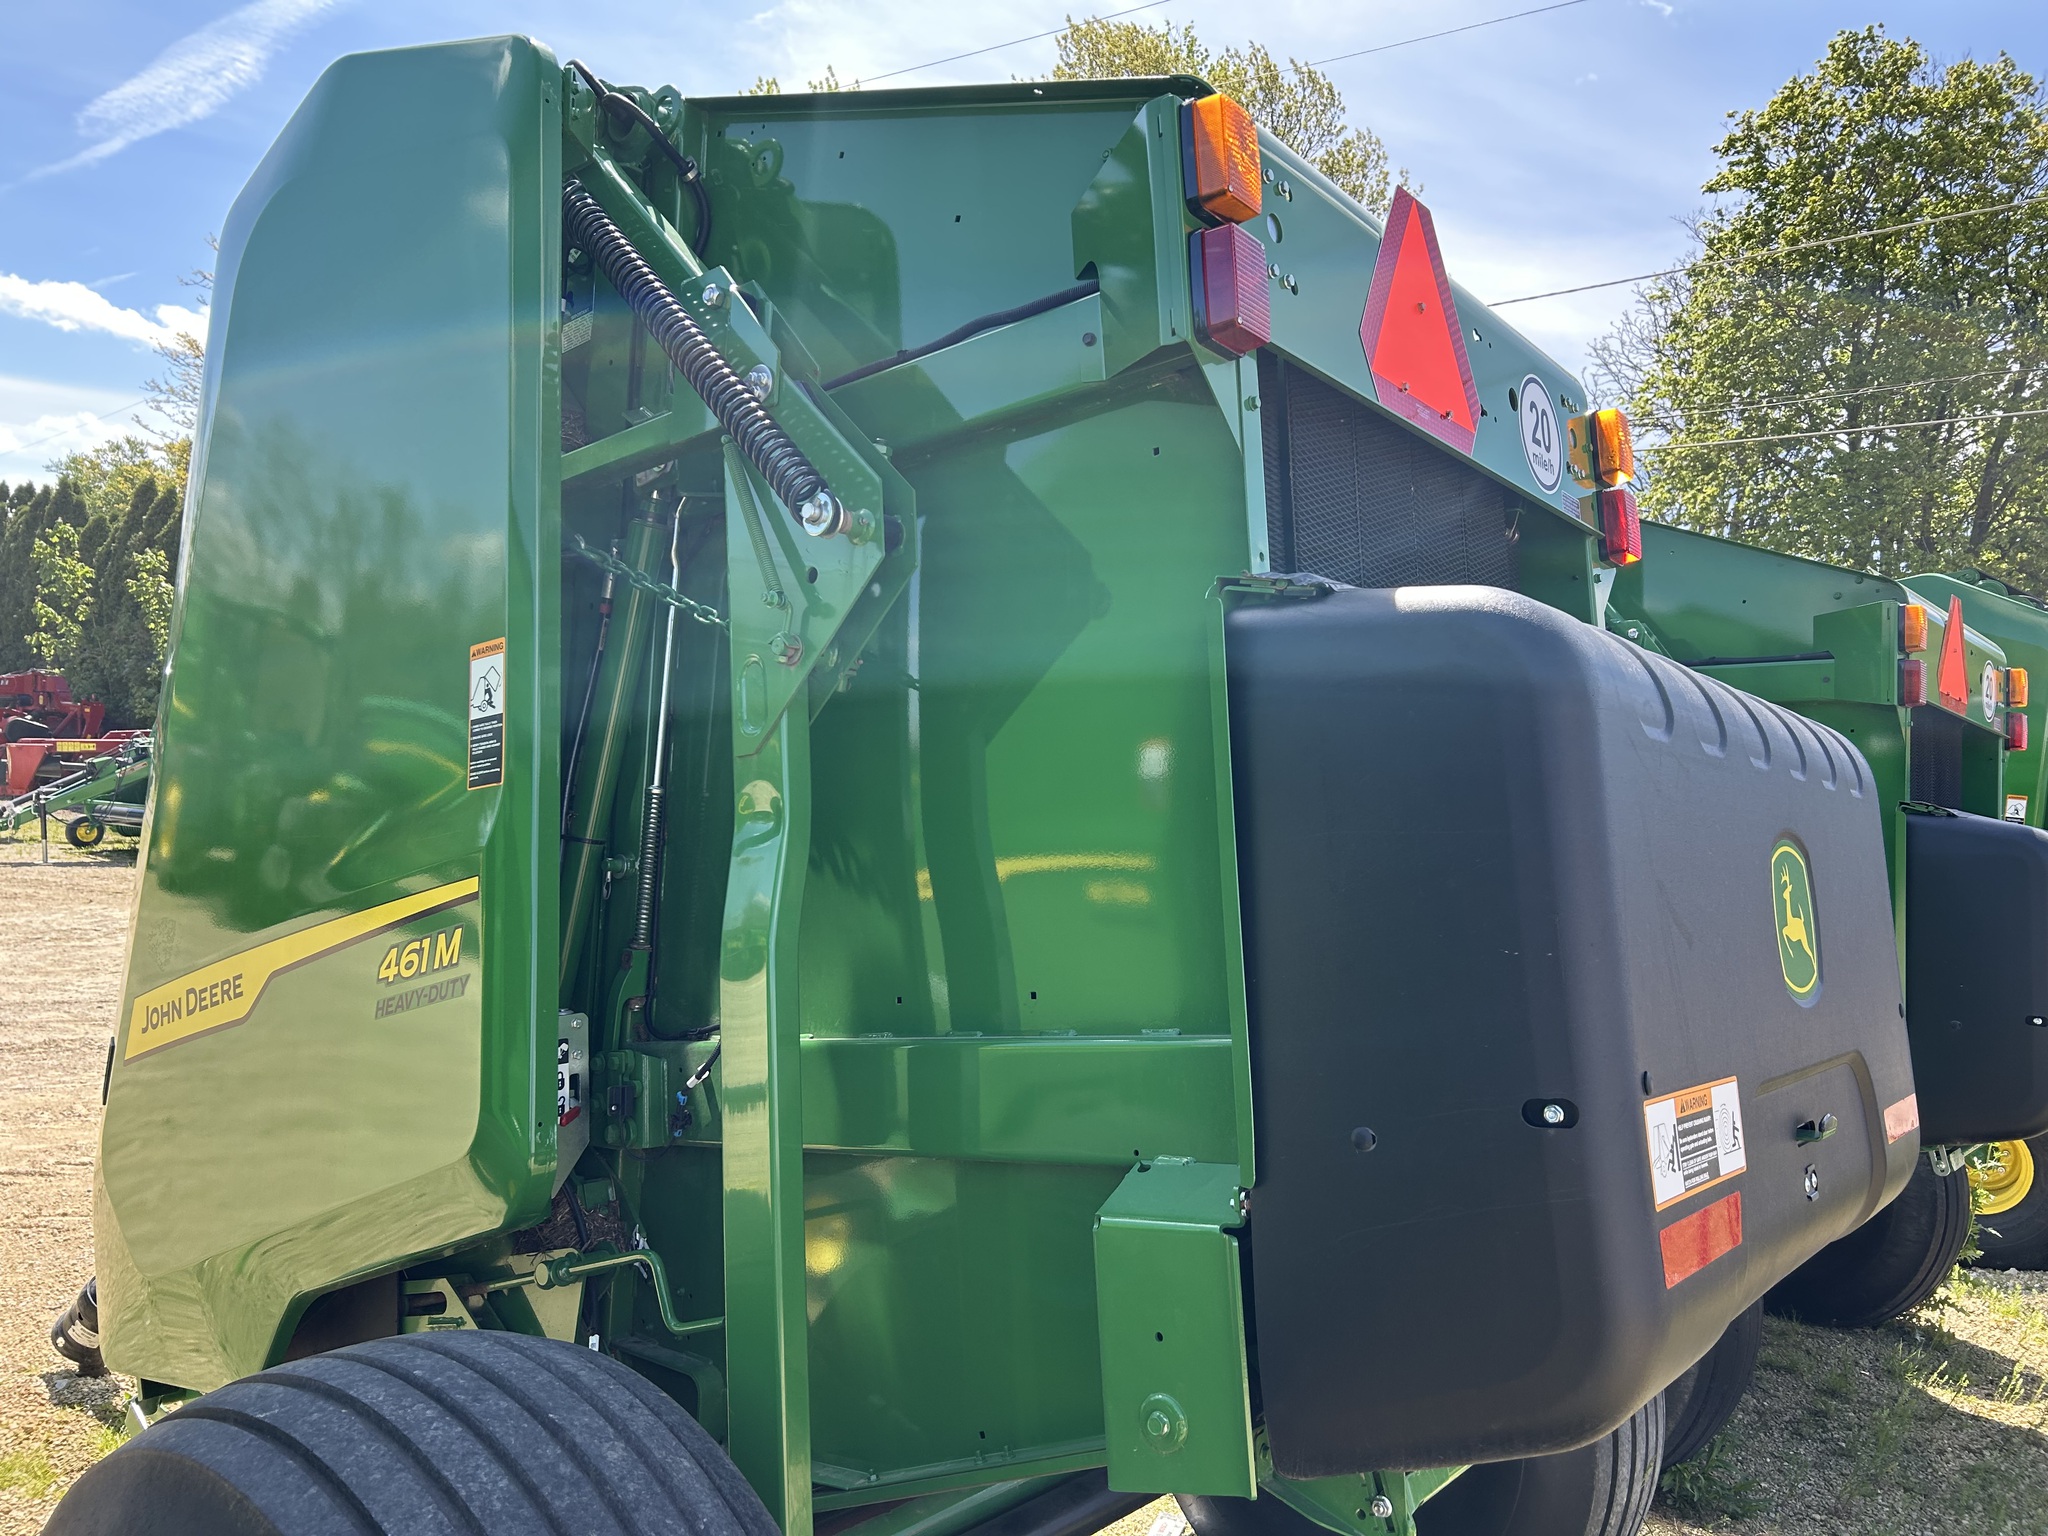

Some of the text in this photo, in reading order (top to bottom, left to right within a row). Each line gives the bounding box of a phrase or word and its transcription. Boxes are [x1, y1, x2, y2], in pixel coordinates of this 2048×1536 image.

[1529, 400, 1552, 454] 20
[1532, 451, 1555, 476] mile/h
[476, 641, 504, 655] WARNING
[378, 926, 463, 984] 461M
[141, 973, 244, 1034] JOHN DEERE
[375, 974, 471, 1019] HEAVY-DUTY
[1685, 1094, 1708, 1112] WARNING
